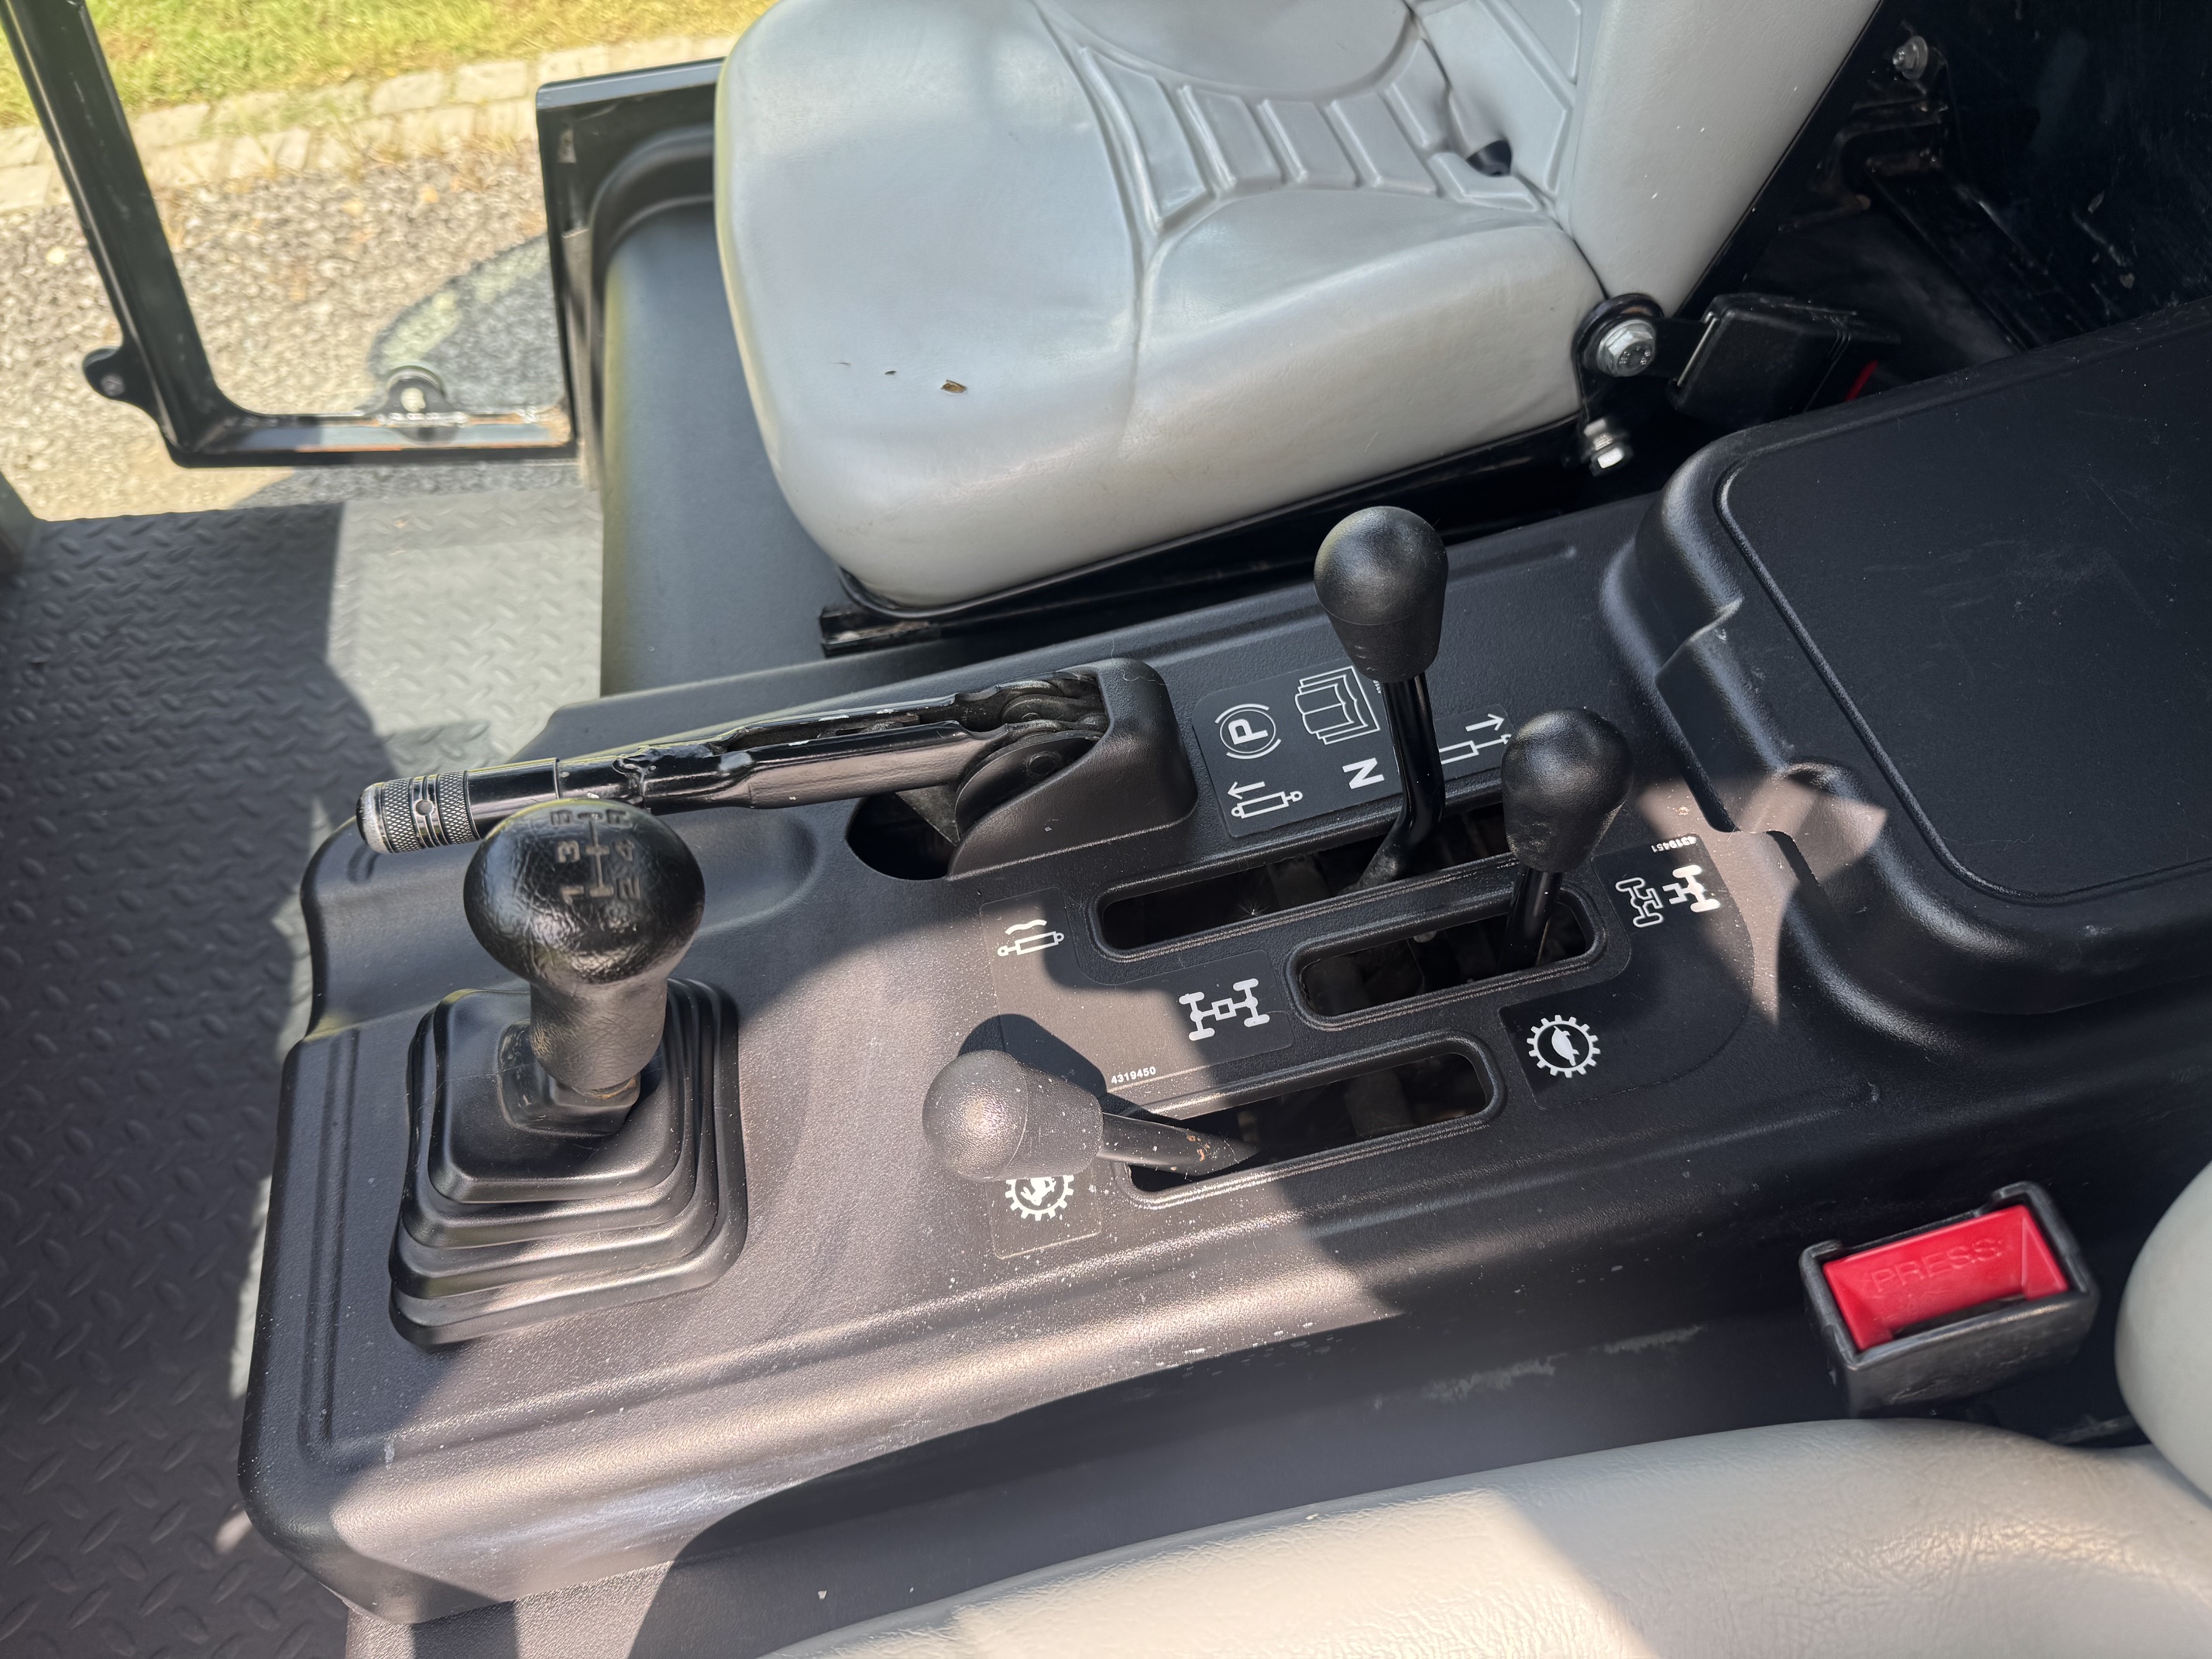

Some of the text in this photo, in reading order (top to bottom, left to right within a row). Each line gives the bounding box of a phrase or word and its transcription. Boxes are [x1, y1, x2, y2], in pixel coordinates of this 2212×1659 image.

[1228, 718, 1269, 746] P
[1342, 757, 1386, 790] N
[557, 839, 581, 864] 3
[611, 837, 635, 862] 4
[560, 884, 585, 905] 1
[615, 876, 641, 901] 2
[1111, 1066, 1156, 1084] 4319450
[1870, 1237, 2004, 1293] PRESS
